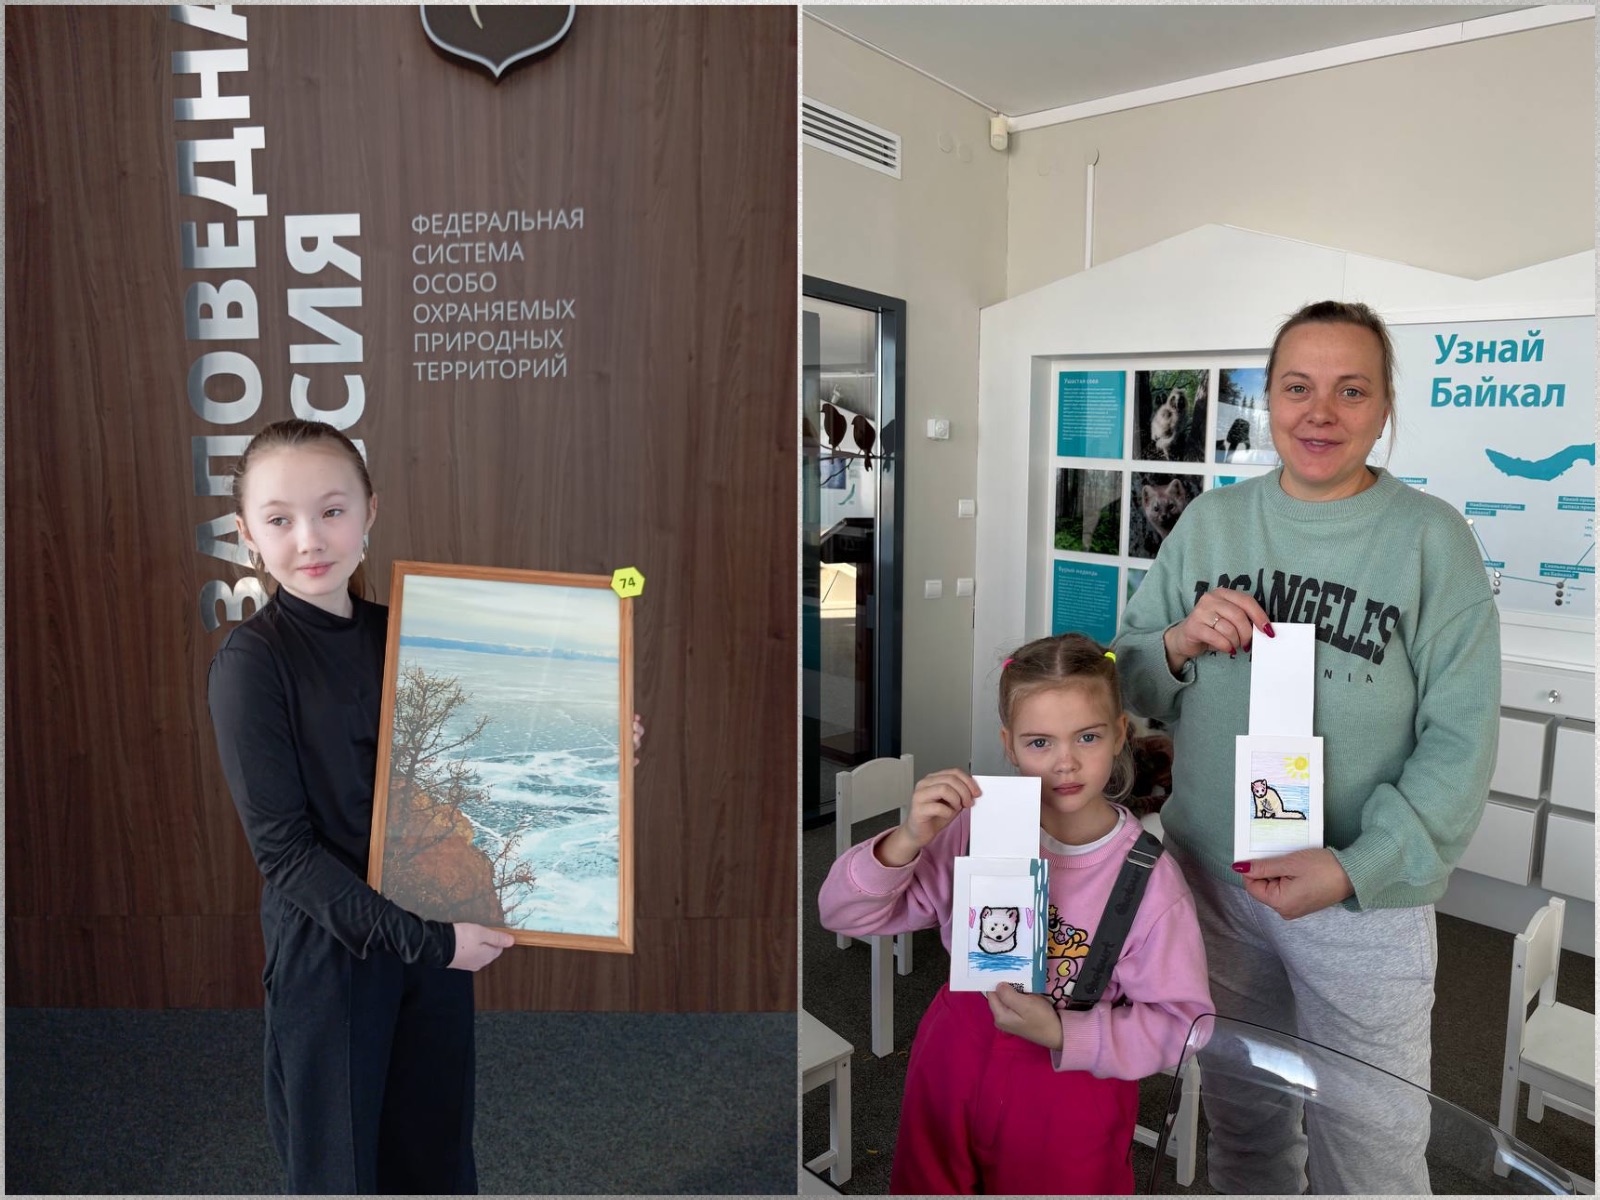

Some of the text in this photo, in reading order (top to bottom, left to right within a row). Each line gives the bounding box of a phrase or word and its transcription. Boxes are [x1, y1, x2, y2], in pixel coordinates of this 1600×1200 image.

[411, 207, 584, 238] ФЕДЕРАЛЬНАЯ
[412, 241, 525, 265] СИСТЕМА
[412, 272, 497, 294] ОСОБО
[413, 299, 576, 324] ОХРАНЯЕМЫХ
[414, 329, 564, 355] ПРИРОДНЫХ
[1434, 330, 1545, 365] Узнай
[413, 353, 568, 382] ТЕРРИТОРИЙ
[1430, 376, 1566, 408] Байкал
[619, 577, 636, 589] 74
